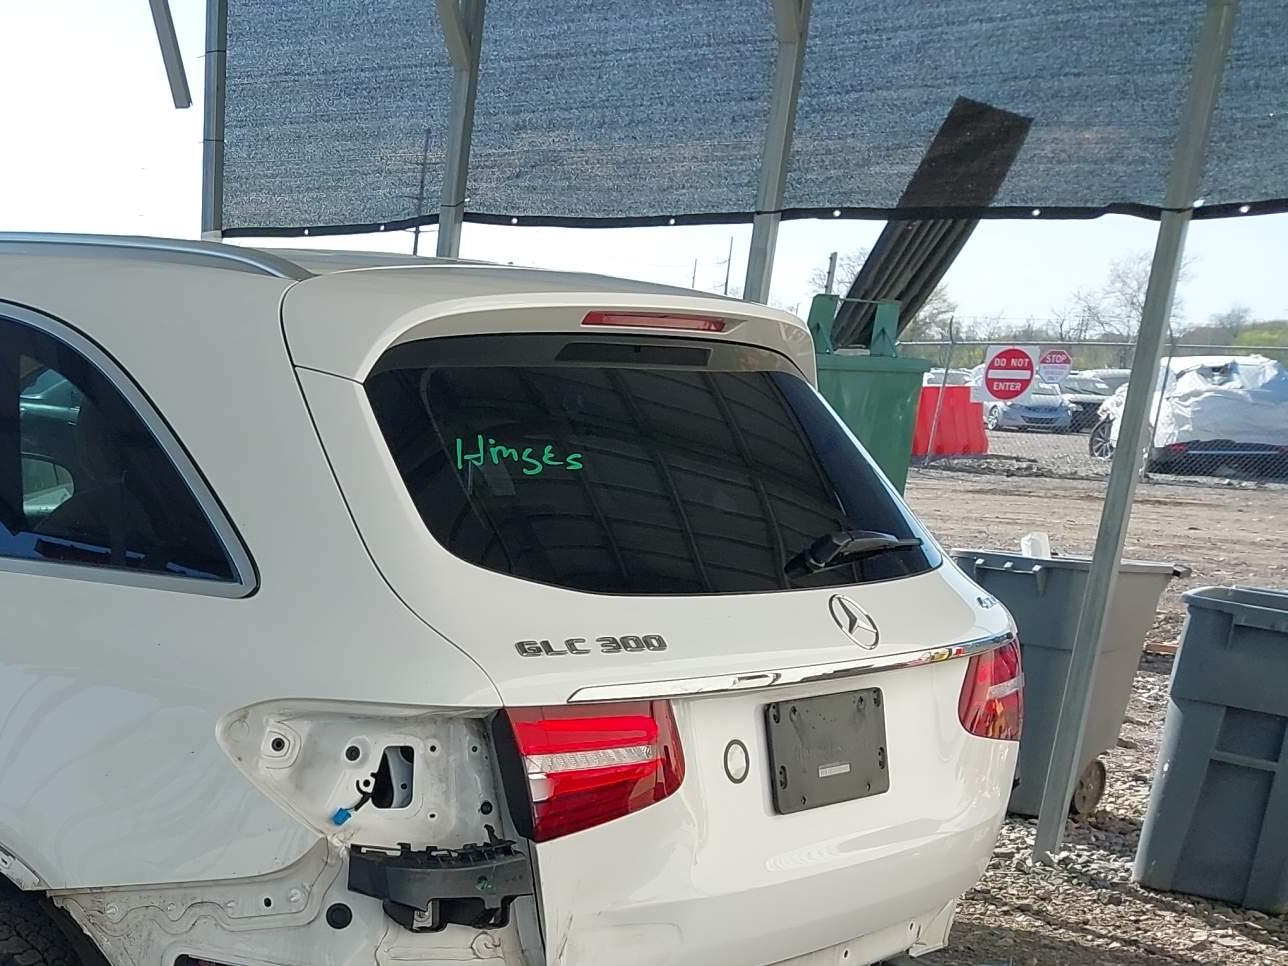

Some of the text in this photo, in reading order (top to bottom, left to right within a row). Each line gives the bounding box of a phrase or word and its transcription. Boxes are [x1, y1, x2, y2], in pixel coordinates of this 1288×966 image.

[994, 358, 1029, 367] DO NOT
[1046, 354, 1067, 363] STOP
[993, 382, 1022, 391] ENTER
[514, 634, 667, 657] GLC 300
